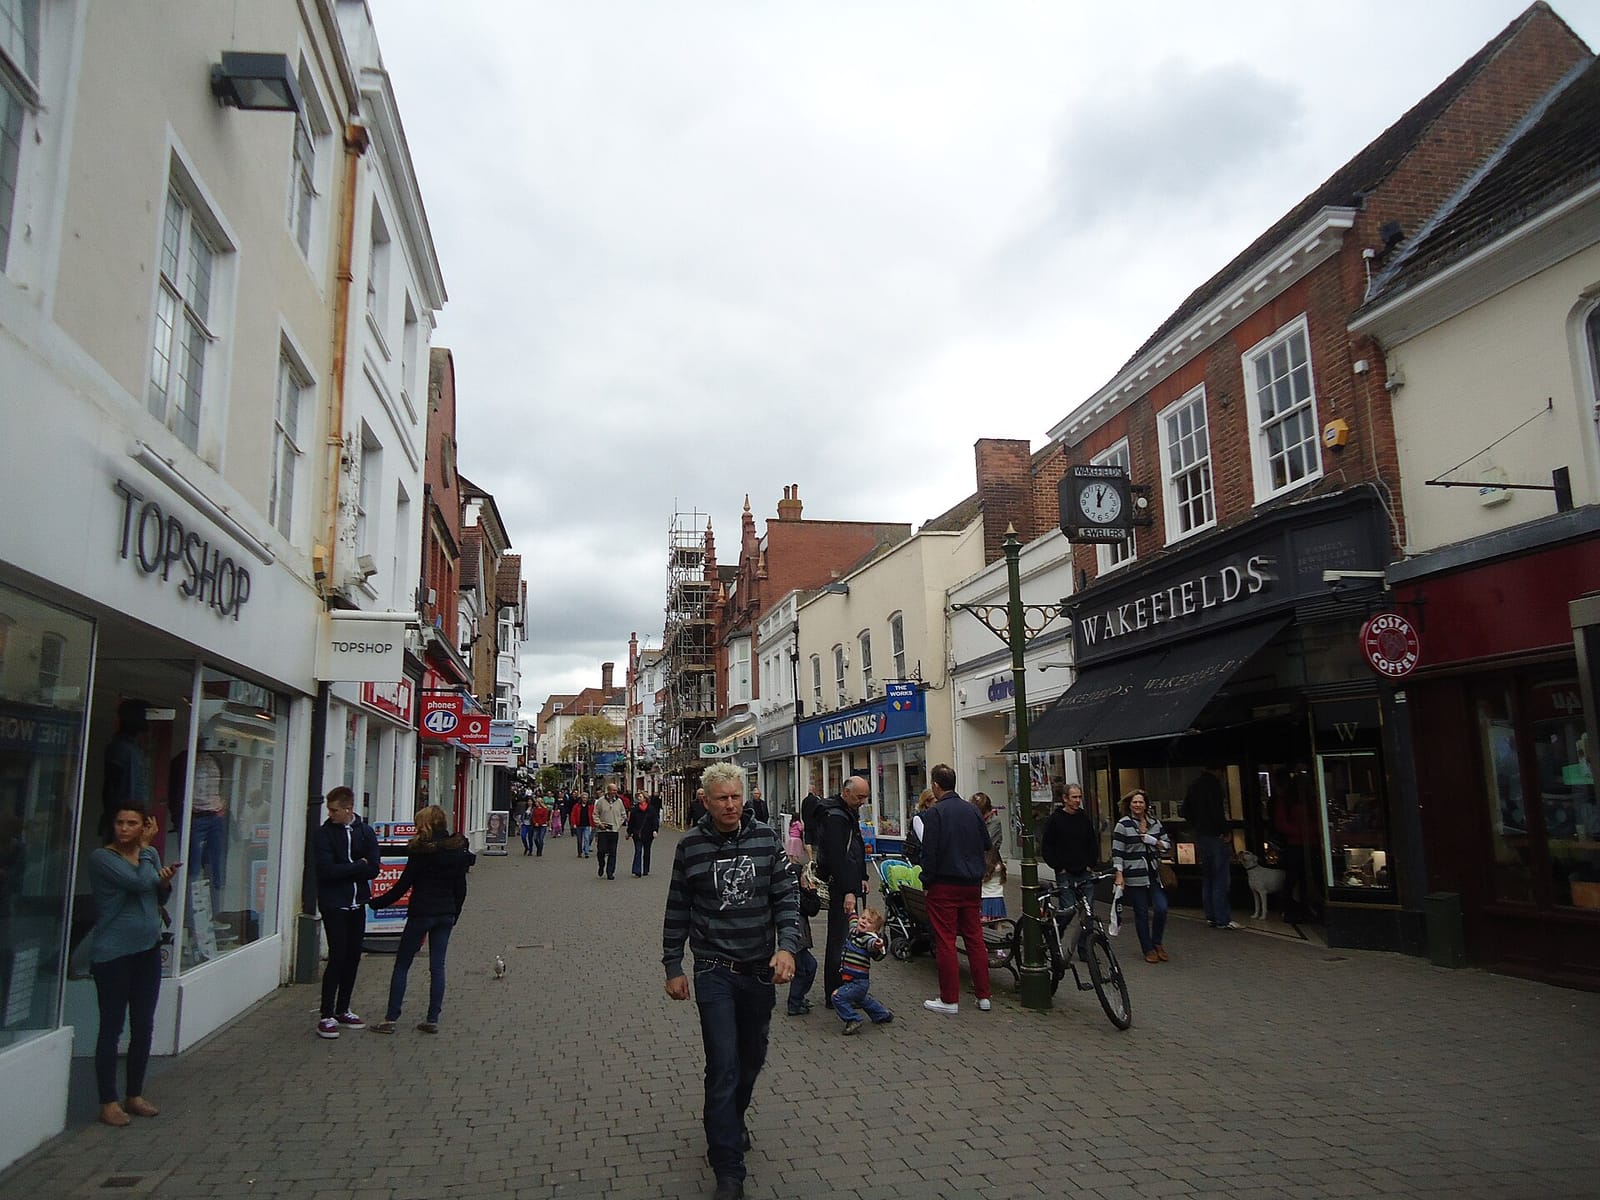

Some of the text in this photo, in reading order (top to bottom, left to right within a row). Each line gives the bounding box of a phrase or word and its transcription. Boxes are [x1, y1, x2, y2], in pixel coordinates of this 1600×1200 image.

[1078, 528, 1126, 538] JEWELLERS
[117, 479, 250, 621] TOPSHOP
[1081, 556, 1264, 646] WAKEFIELDS
[1372, 616, 1410, 635] COSTA
[331, 642, 393, 654] TOPSHOP
[1372, 652, 1416, 673] COFFEE
[427, 701, 457, 710] phones
[428, 712, 455, 732] 4u
[826, 714, 877, 742] THE WORKS
[1332, 722, 1360, 743] W
